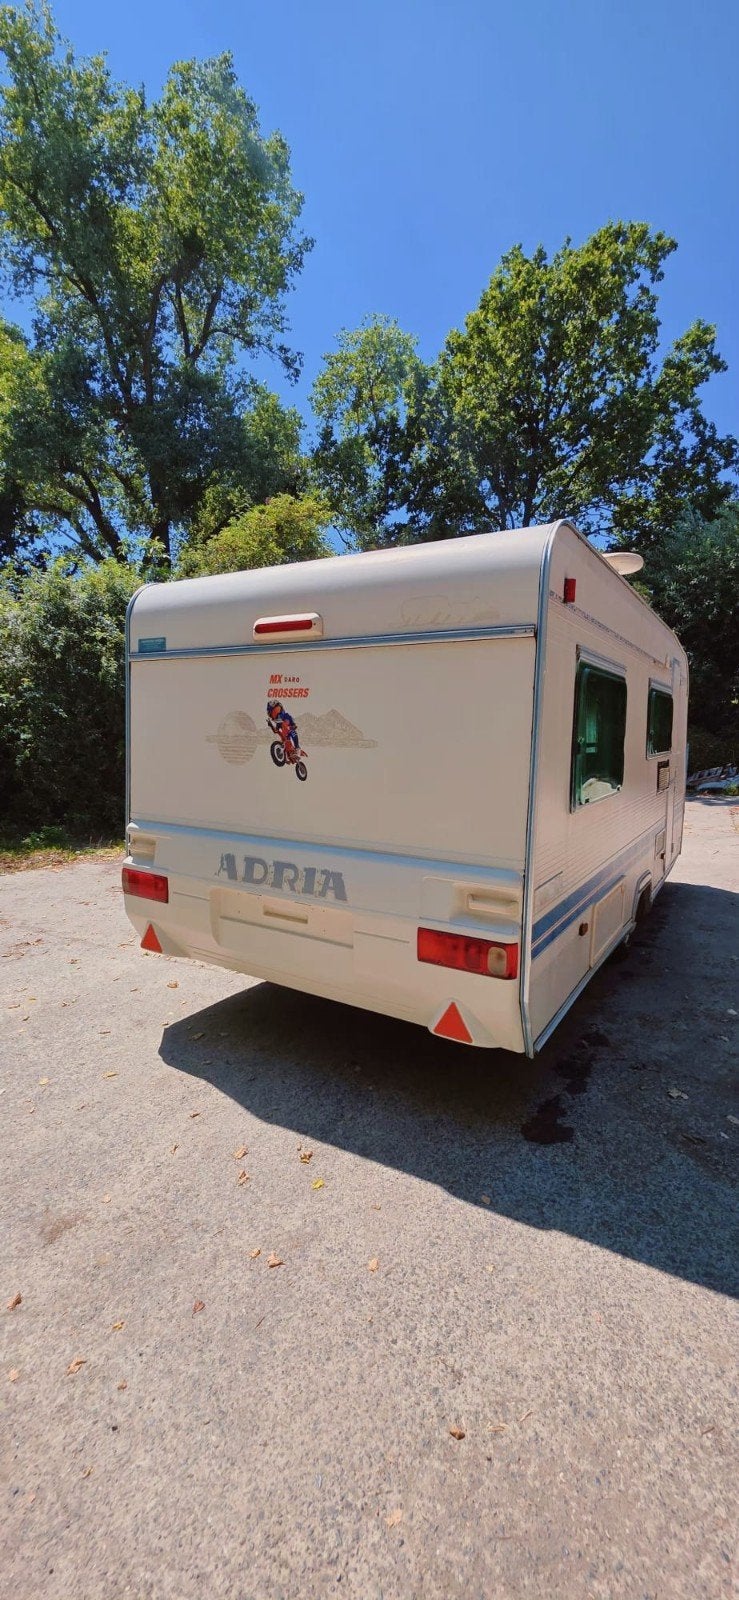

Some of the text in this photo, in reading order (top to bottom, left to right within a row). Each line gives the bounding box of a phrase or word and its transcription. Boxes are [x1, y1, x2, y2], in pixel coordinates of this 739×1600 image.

[269, 674, 283, 684] MX
[267, 688, 309, 698] CROSSERS
[215, 853, 348, 901] ADRIA
